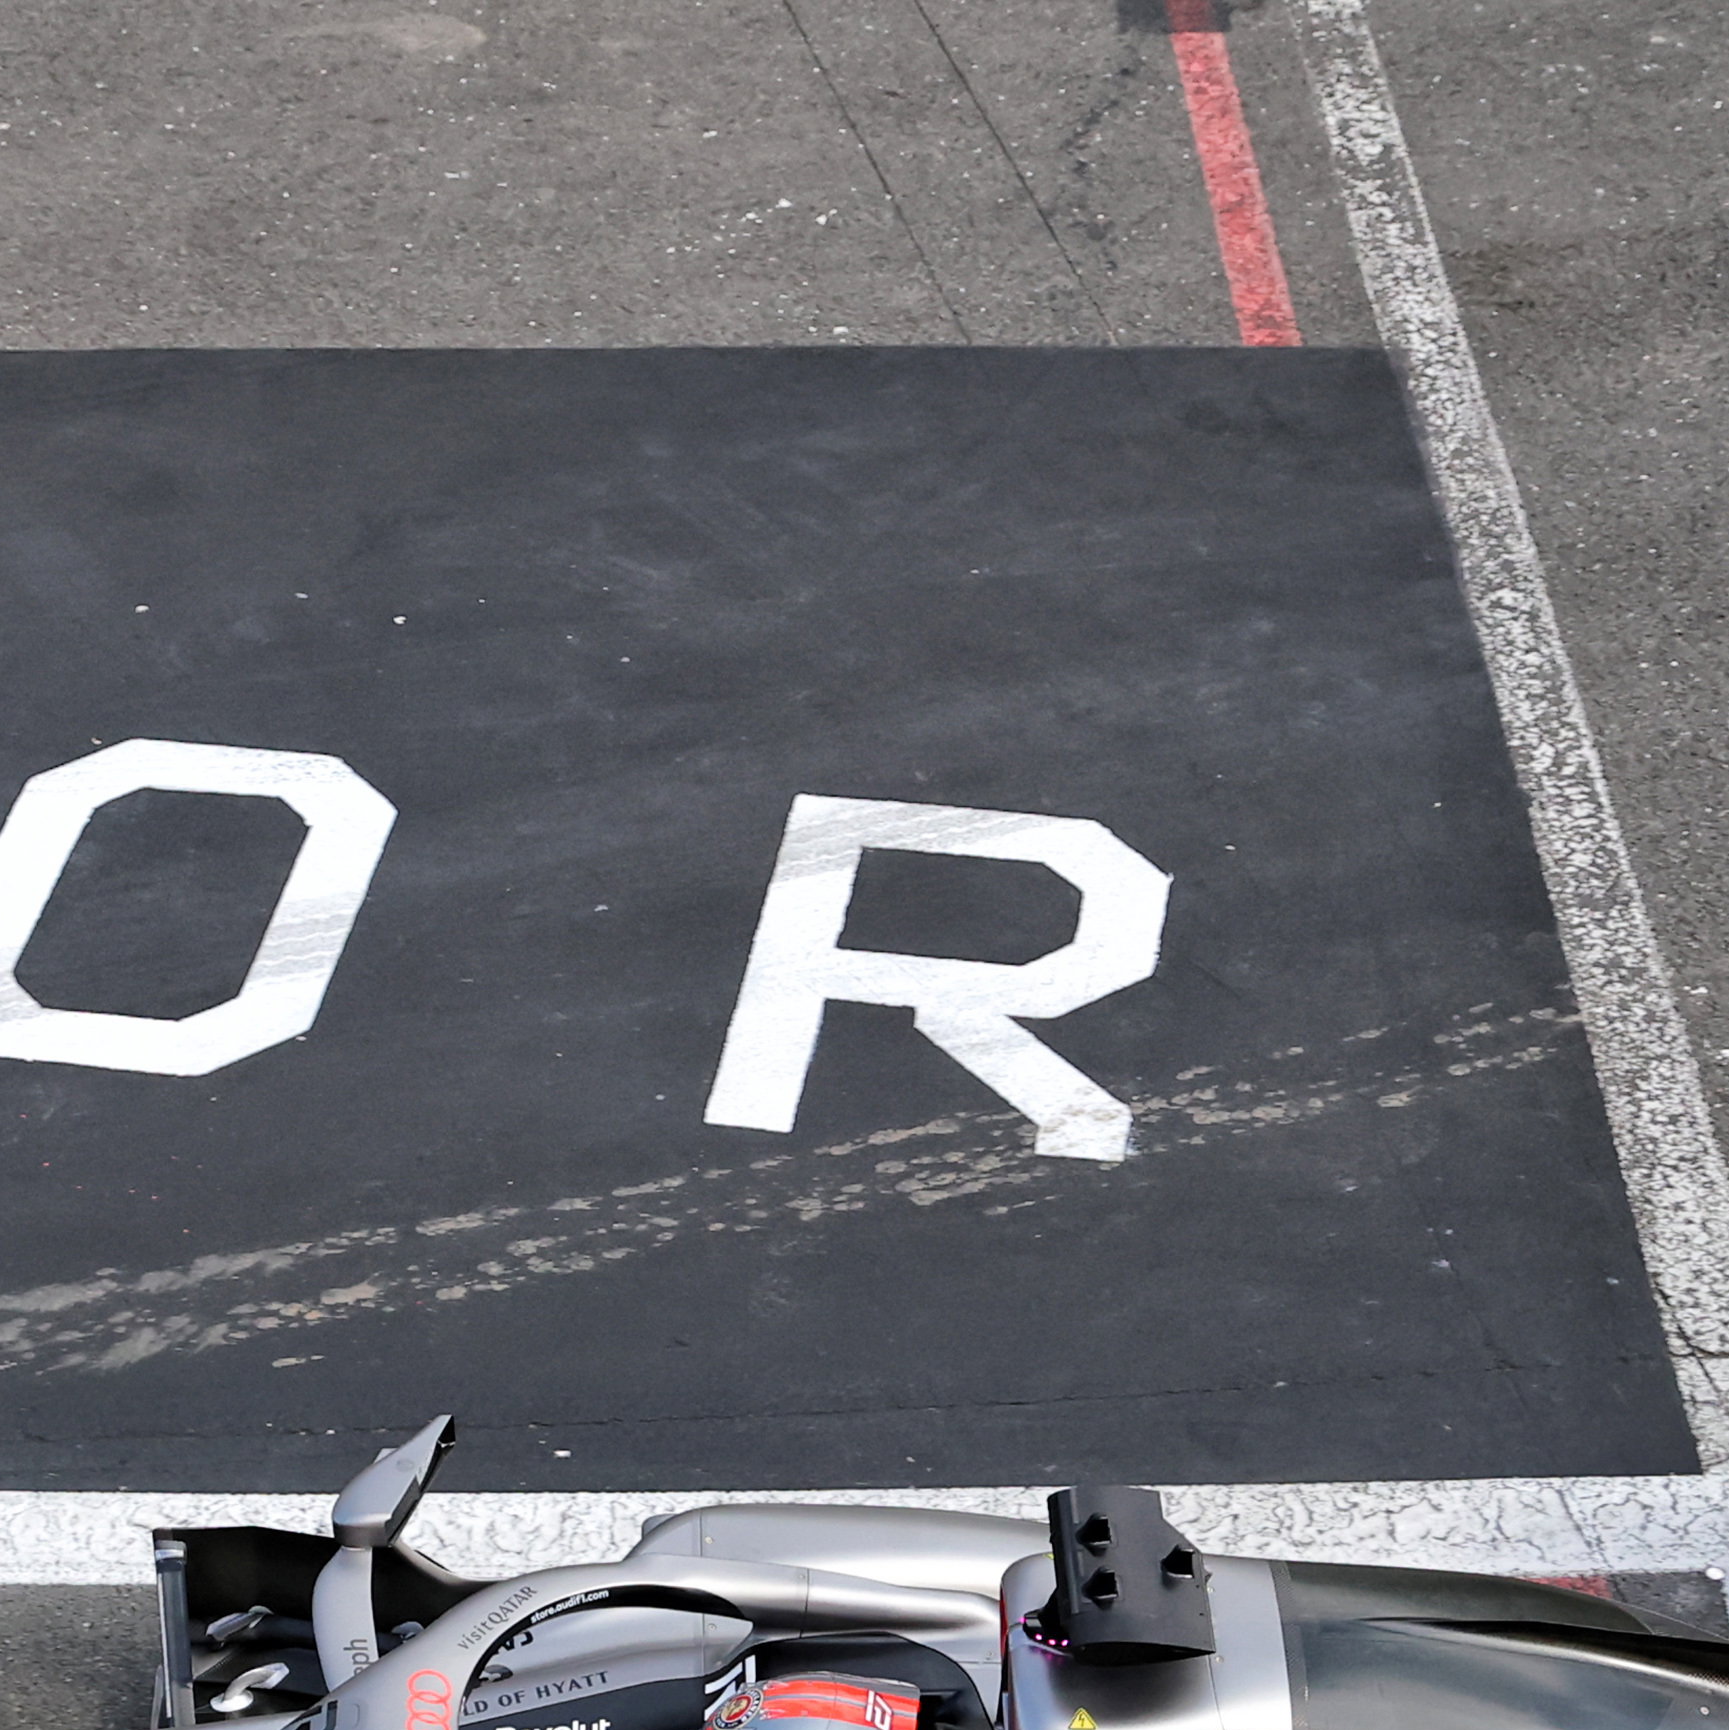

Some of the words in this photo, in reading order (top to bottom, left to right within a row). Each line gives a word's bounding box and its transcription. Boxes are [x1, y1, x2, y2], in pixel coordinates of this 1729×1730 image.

[530, 1588, 610, 1625] store.audif1.com
[497, 1691, 527, 1708] OF
[536, 1670, 610, 1699] HYATT
